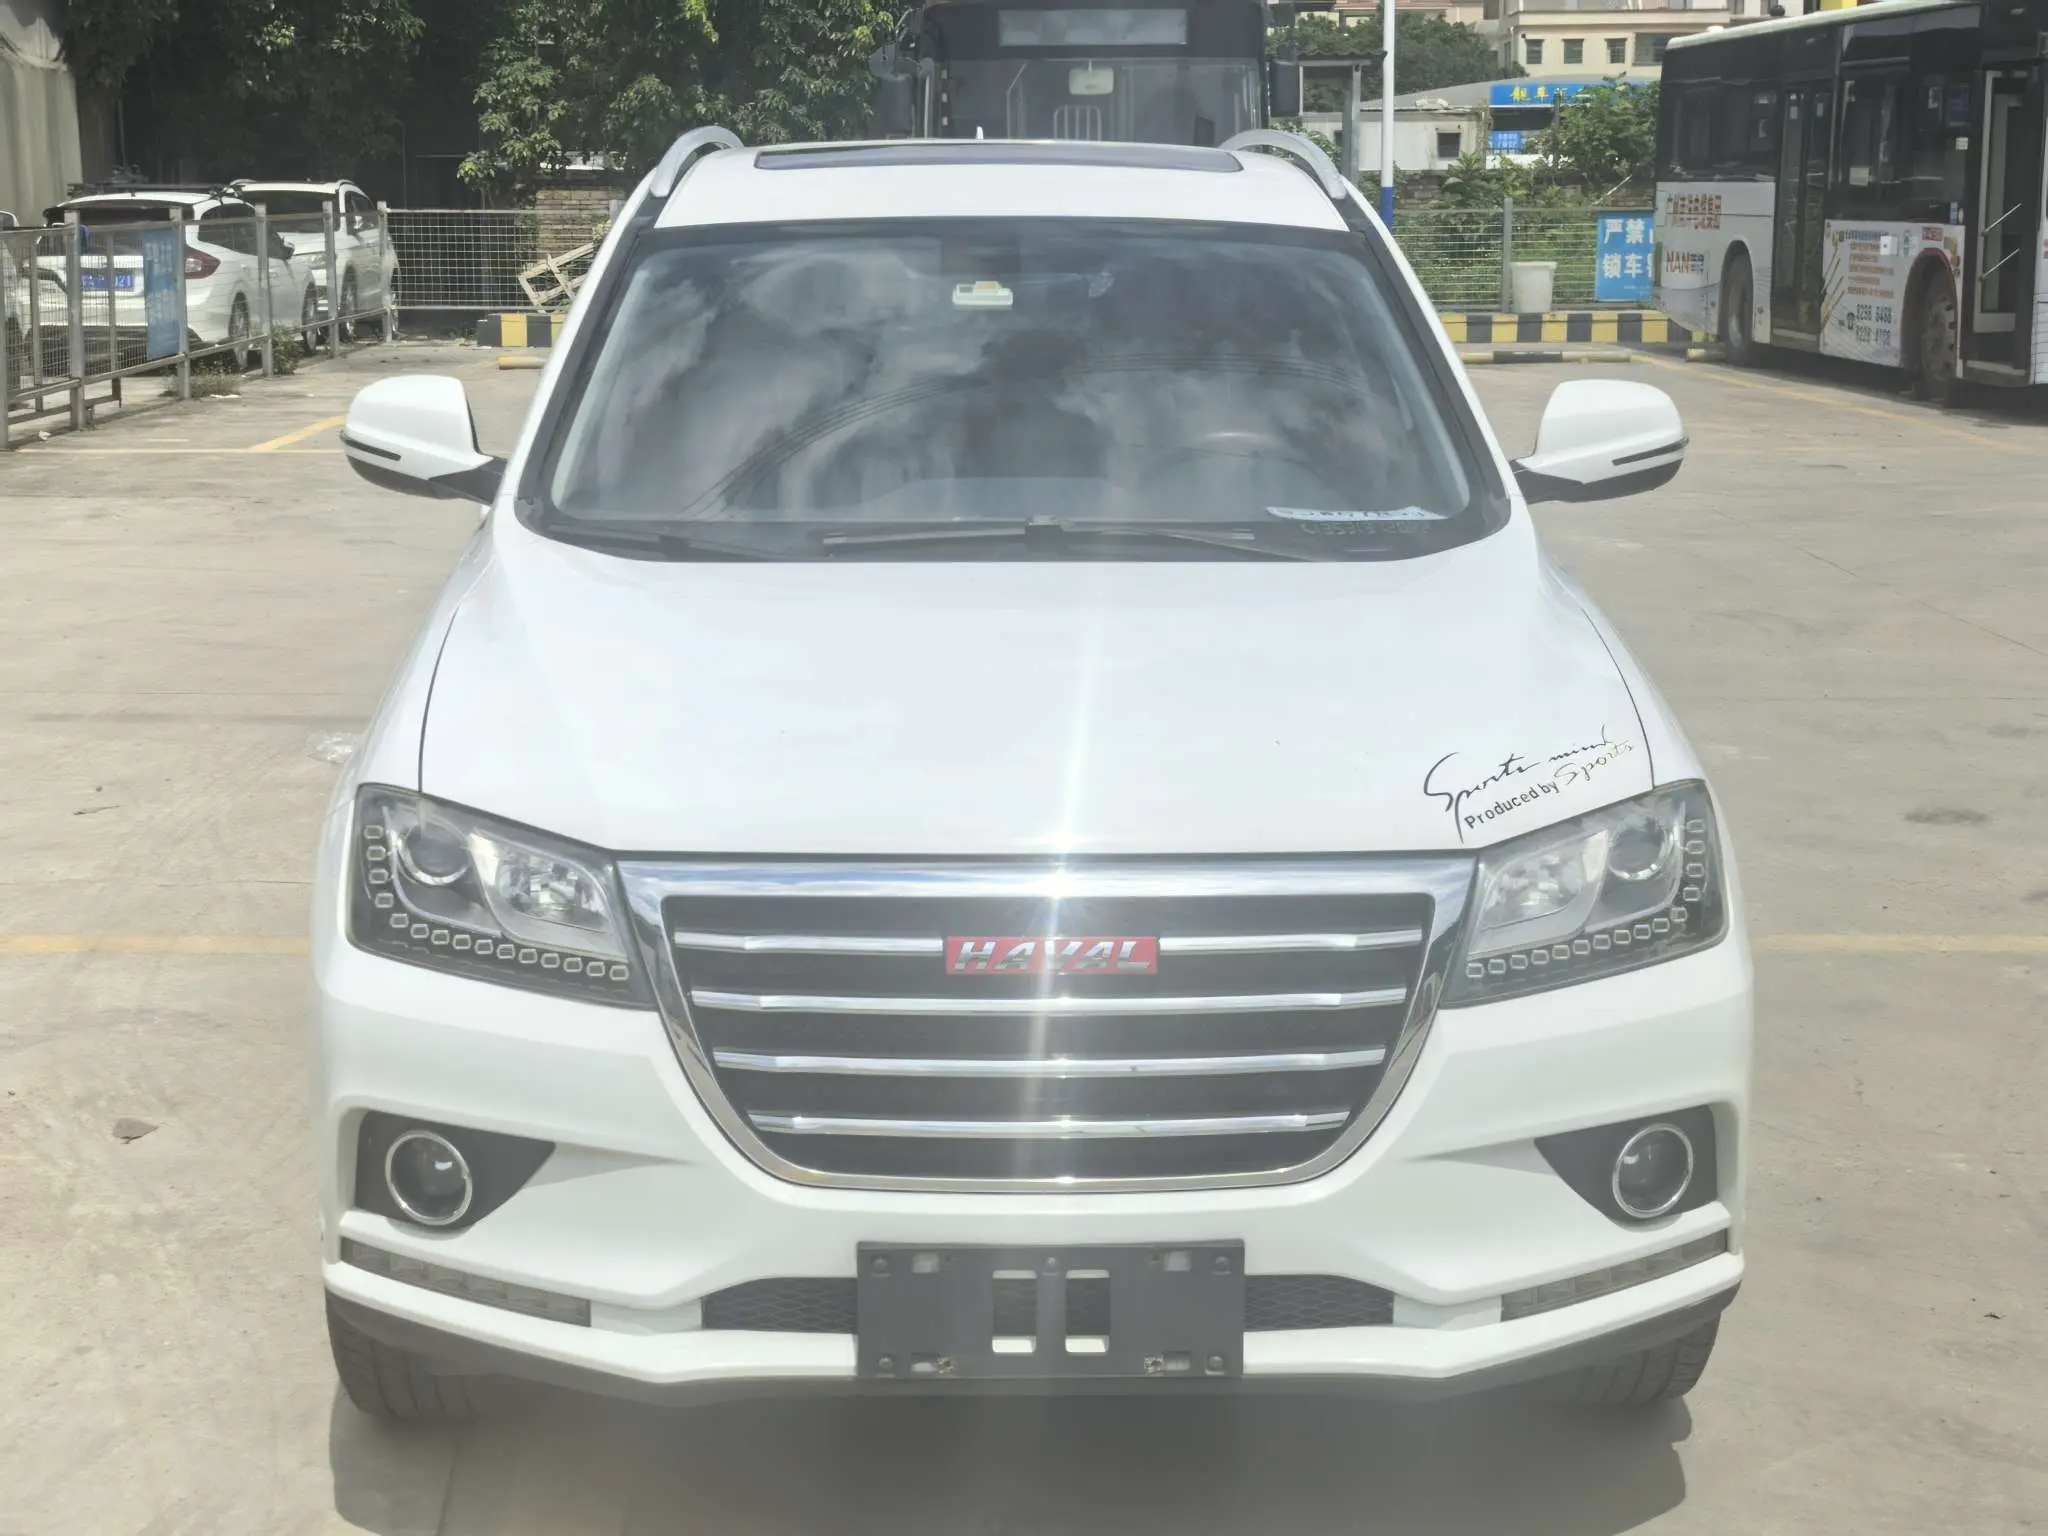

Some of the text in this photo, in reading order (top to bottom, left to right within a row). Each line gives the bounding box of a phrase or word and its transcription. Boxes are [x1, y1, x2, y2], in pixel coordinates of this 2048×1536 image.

[1464, 740, 1634, 829] Produced by Sports
[954, 940, 1150, 971] HAVAL
